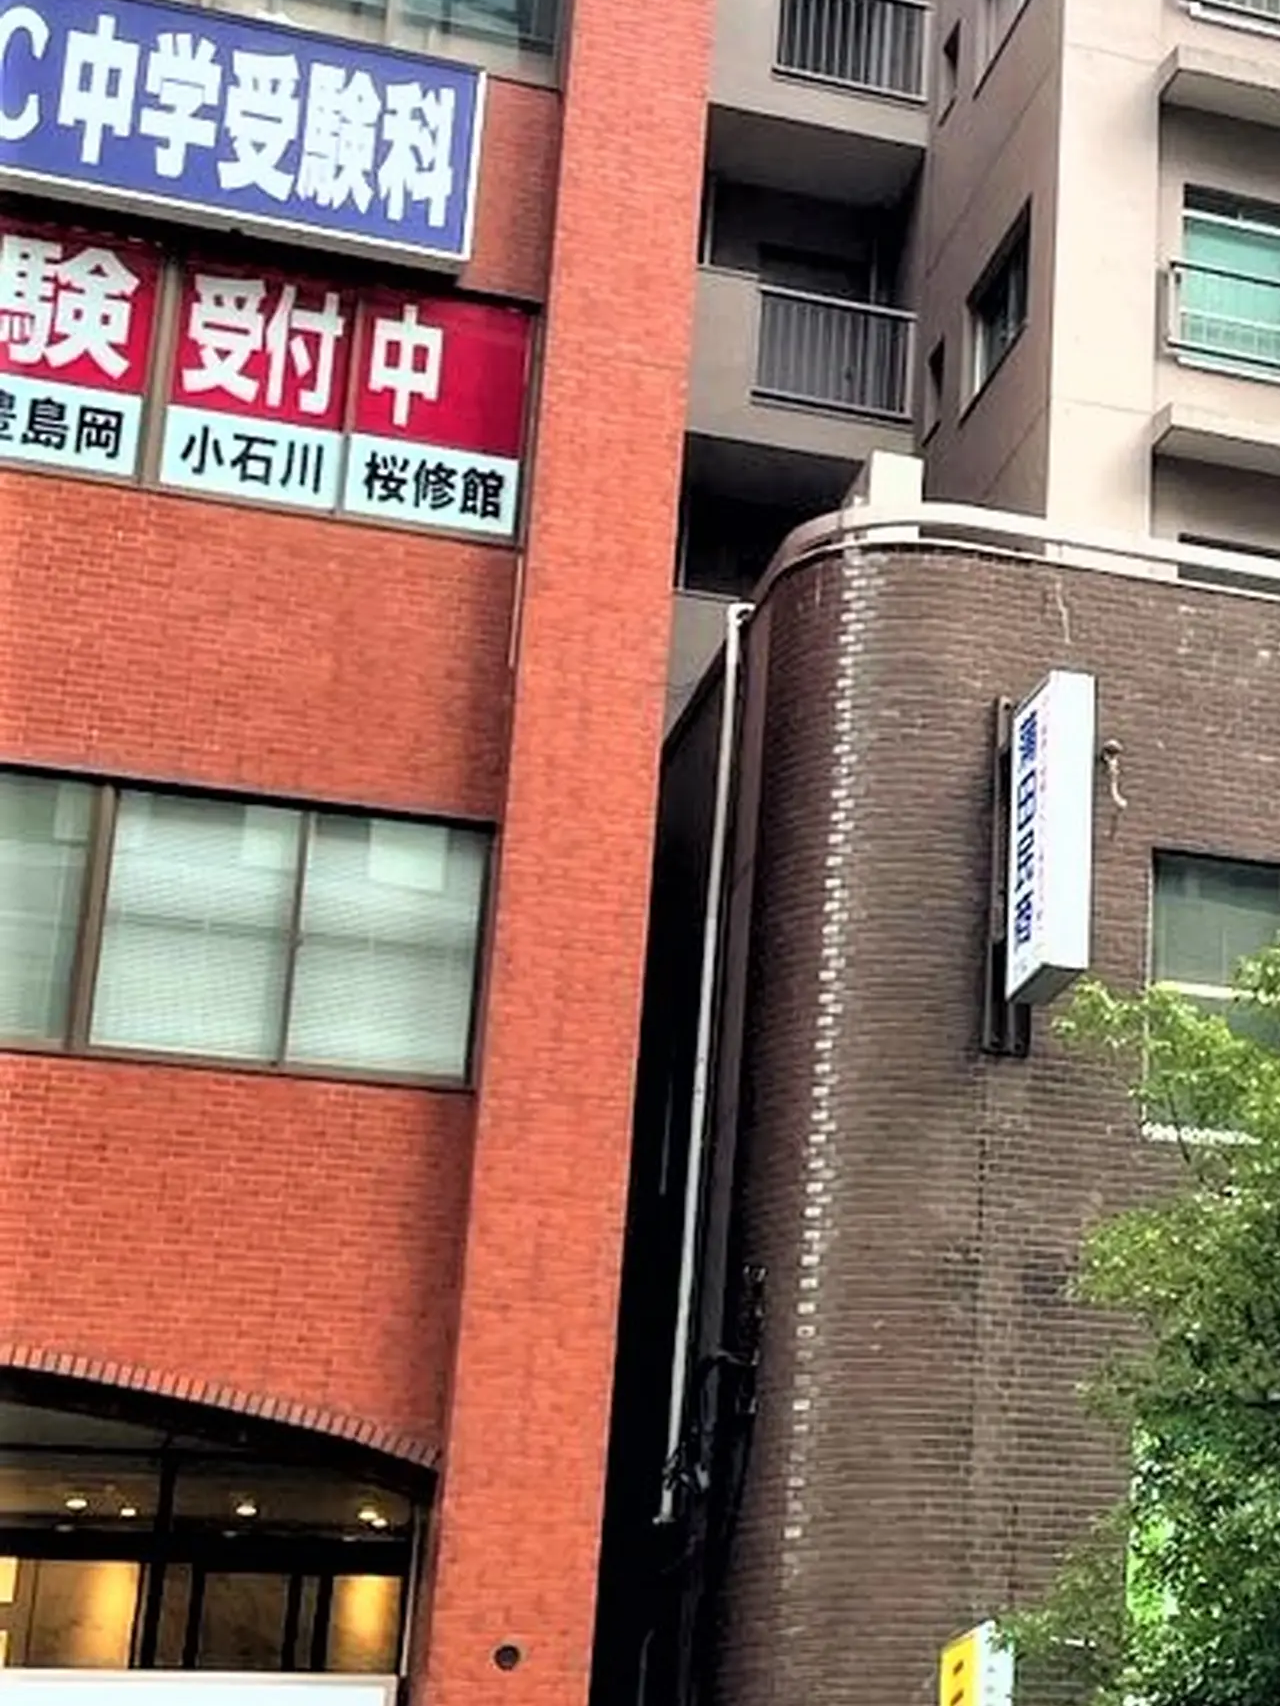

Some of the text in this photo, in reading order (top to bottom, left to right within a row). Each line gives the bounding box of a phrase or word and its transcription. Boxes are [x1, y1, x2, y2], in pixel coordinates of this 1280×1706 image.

[180, 425, 325, 494] 小石川
[363, 451, 505, 520] 桜修館
